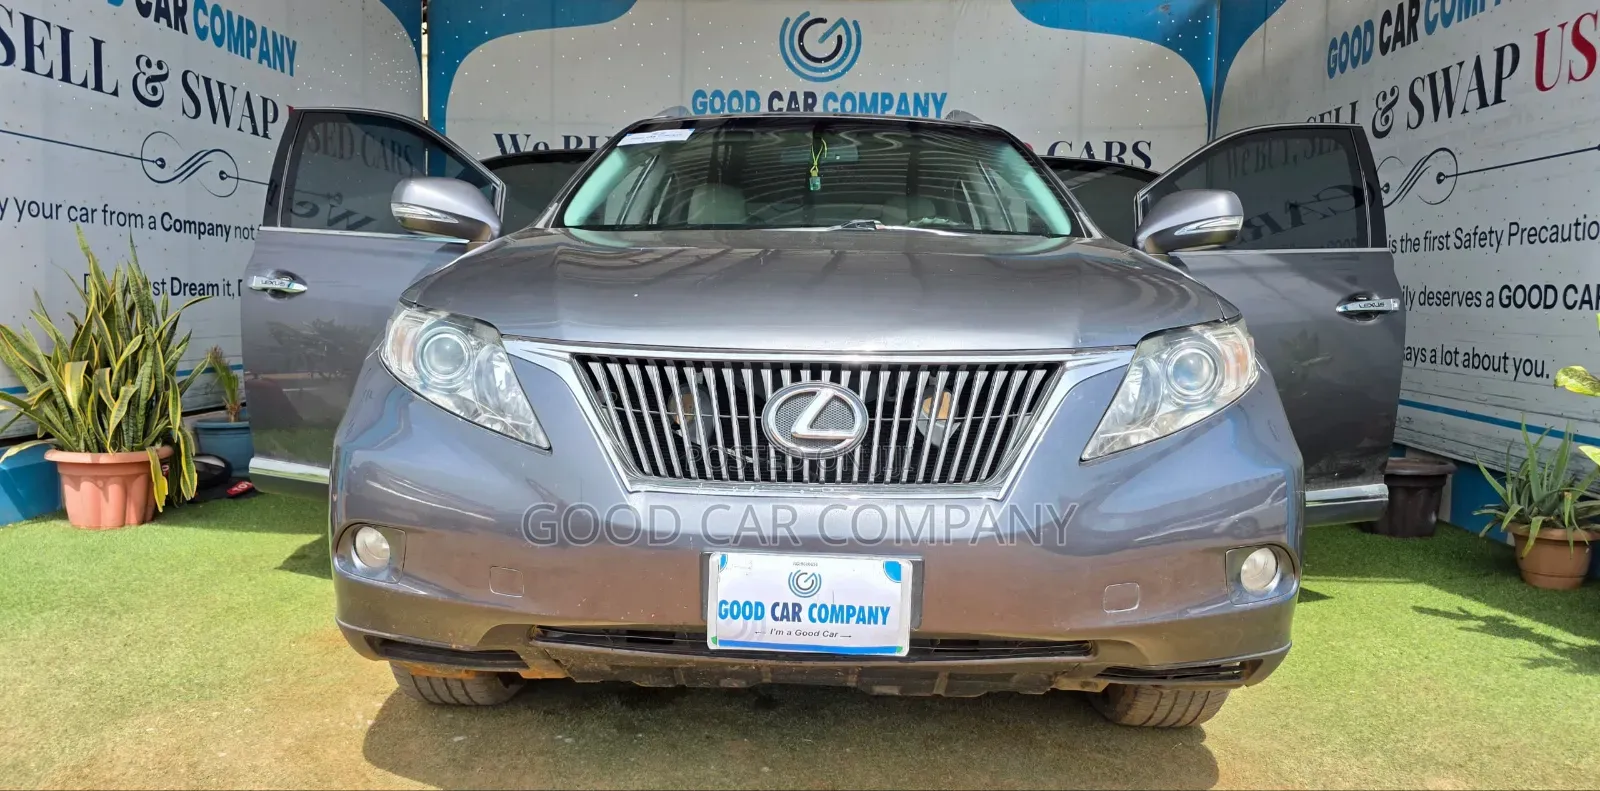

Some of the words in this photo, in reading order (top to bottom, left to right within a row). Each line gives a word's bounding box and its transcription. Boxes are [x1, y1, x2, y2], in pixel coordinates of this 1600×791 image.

[193, 0, 297, 77] COMPANY
[1327, 19, 1374, 79] GOOD
[1379, 0, 1420, 56] CAR
[1372, 85, 1399, 139] &
[1406, 42, 1520, 131] SWAP
[1533, 10, 1598, 92] US
[132, 54, 169, 108] &
[181, 69, 279, 140] SWAP
[692, 89, 761, 116] GOOD
[767, 91, 818, 113] CAR
[823, 91, 948, 119] COMPANY
[13, 196, 63, 222] your
[67, 205, 98, 224] car
[103, 203, 144, 228] from
[148, 214, 157, 230] a
[160, 211, 231, 242] Company
[234, 224, 255, 241] not
[1388, 235, 1397, 254] is
[1400, 233, 1420, 253] the
[1424, 230, 1450, 252] first
[1453, 225, 1504, 253] Safety
[1508, 213, 1600, 246] Precautio
[149, 278, 166, 296] st
[170, 276, 219, 296] Dream
[222, 278, 235, 299] it,
[1418, 284, 1482, 307] deserves
[1485, 290, 1494, 308] a
[1500, 283, 1558, 310] GOOD
[1430, 348, 1437, 364] a
[1440, 344, 1459, 367] lot
[1462, 347, 1509, 373] about
[1513, 356, 1550, 382] you.
[718, 599, 765, 621] GOOD
[770, 601, 803, 623] CAR
[807, 602, 891, 625] COMPANY
[769, 628, 784, 636] I'm
[794, 629, 820, 637] Good
[822, 630, 839, 638] Car
